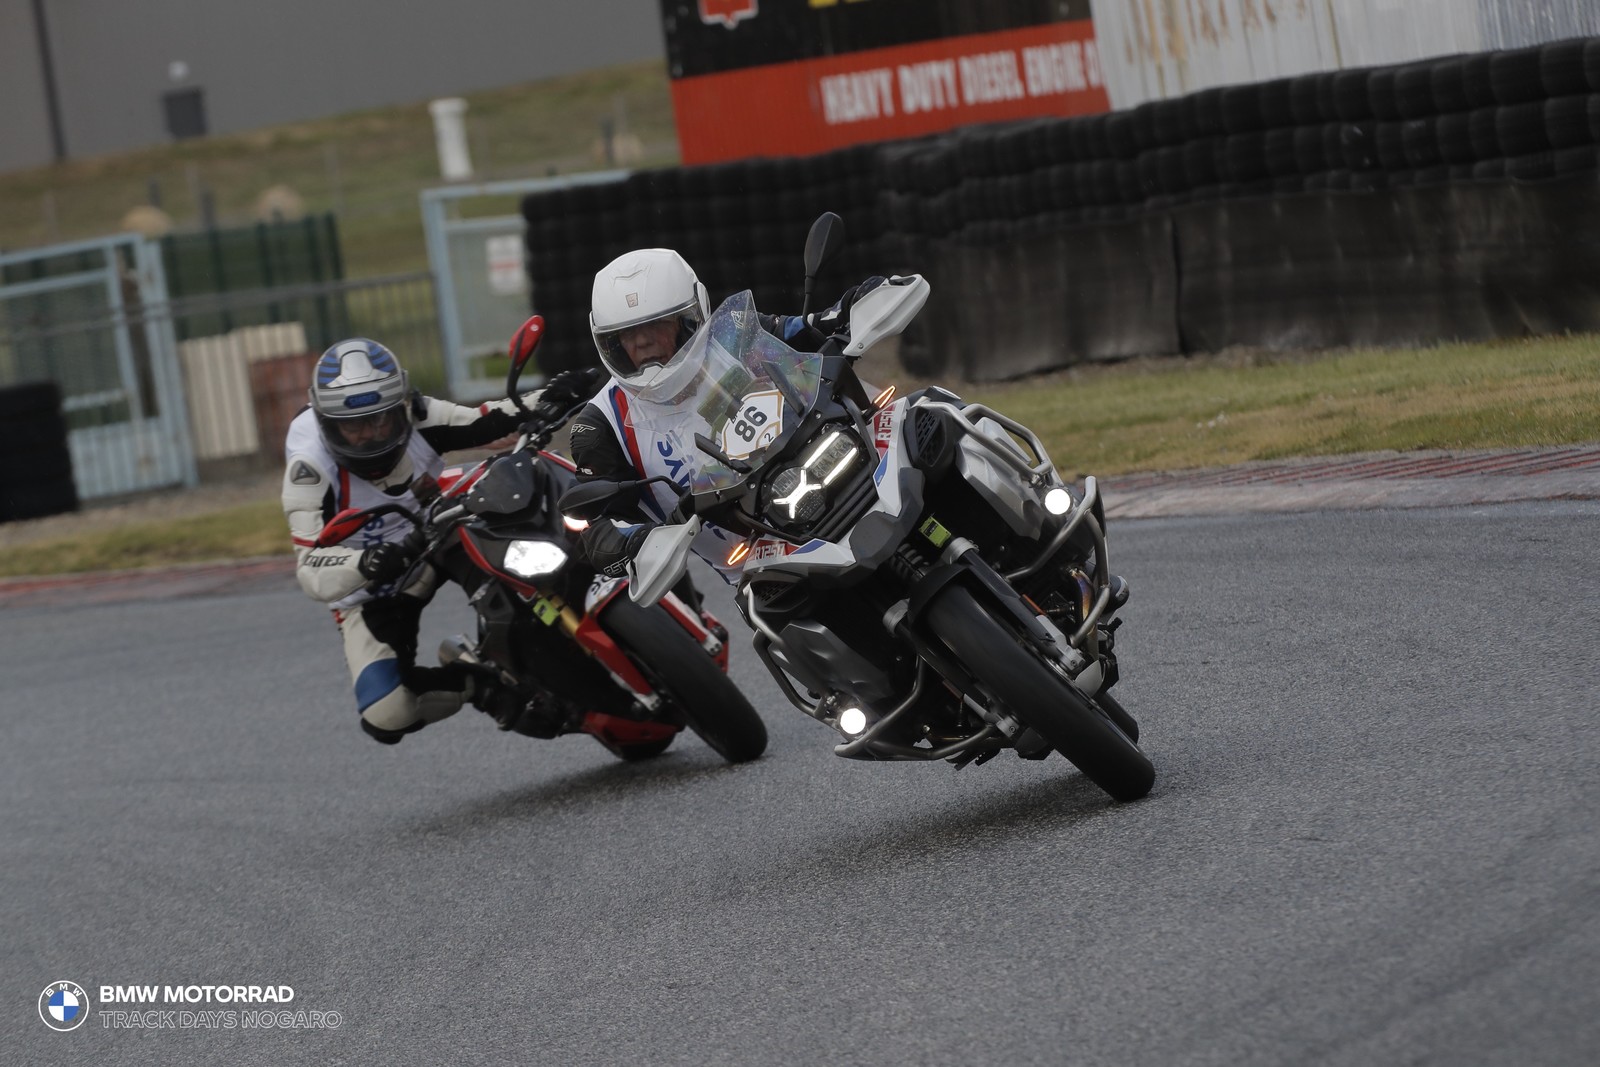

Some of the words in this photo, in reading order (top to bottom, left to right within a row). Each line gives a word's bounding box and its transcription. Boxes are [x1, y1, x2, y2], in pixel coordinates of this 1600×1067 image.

[820, 68, 894, 125] HEAVY
[897, 59, 959, 114] DUTY
[958, 50, 1025, 105] DIESEL
[1023, 42, 1087, 97] ENGINE
[570, 423, 597, 434] ST
[735, 406, 768, 443] 86
[764, 432, 775, 443] 2
